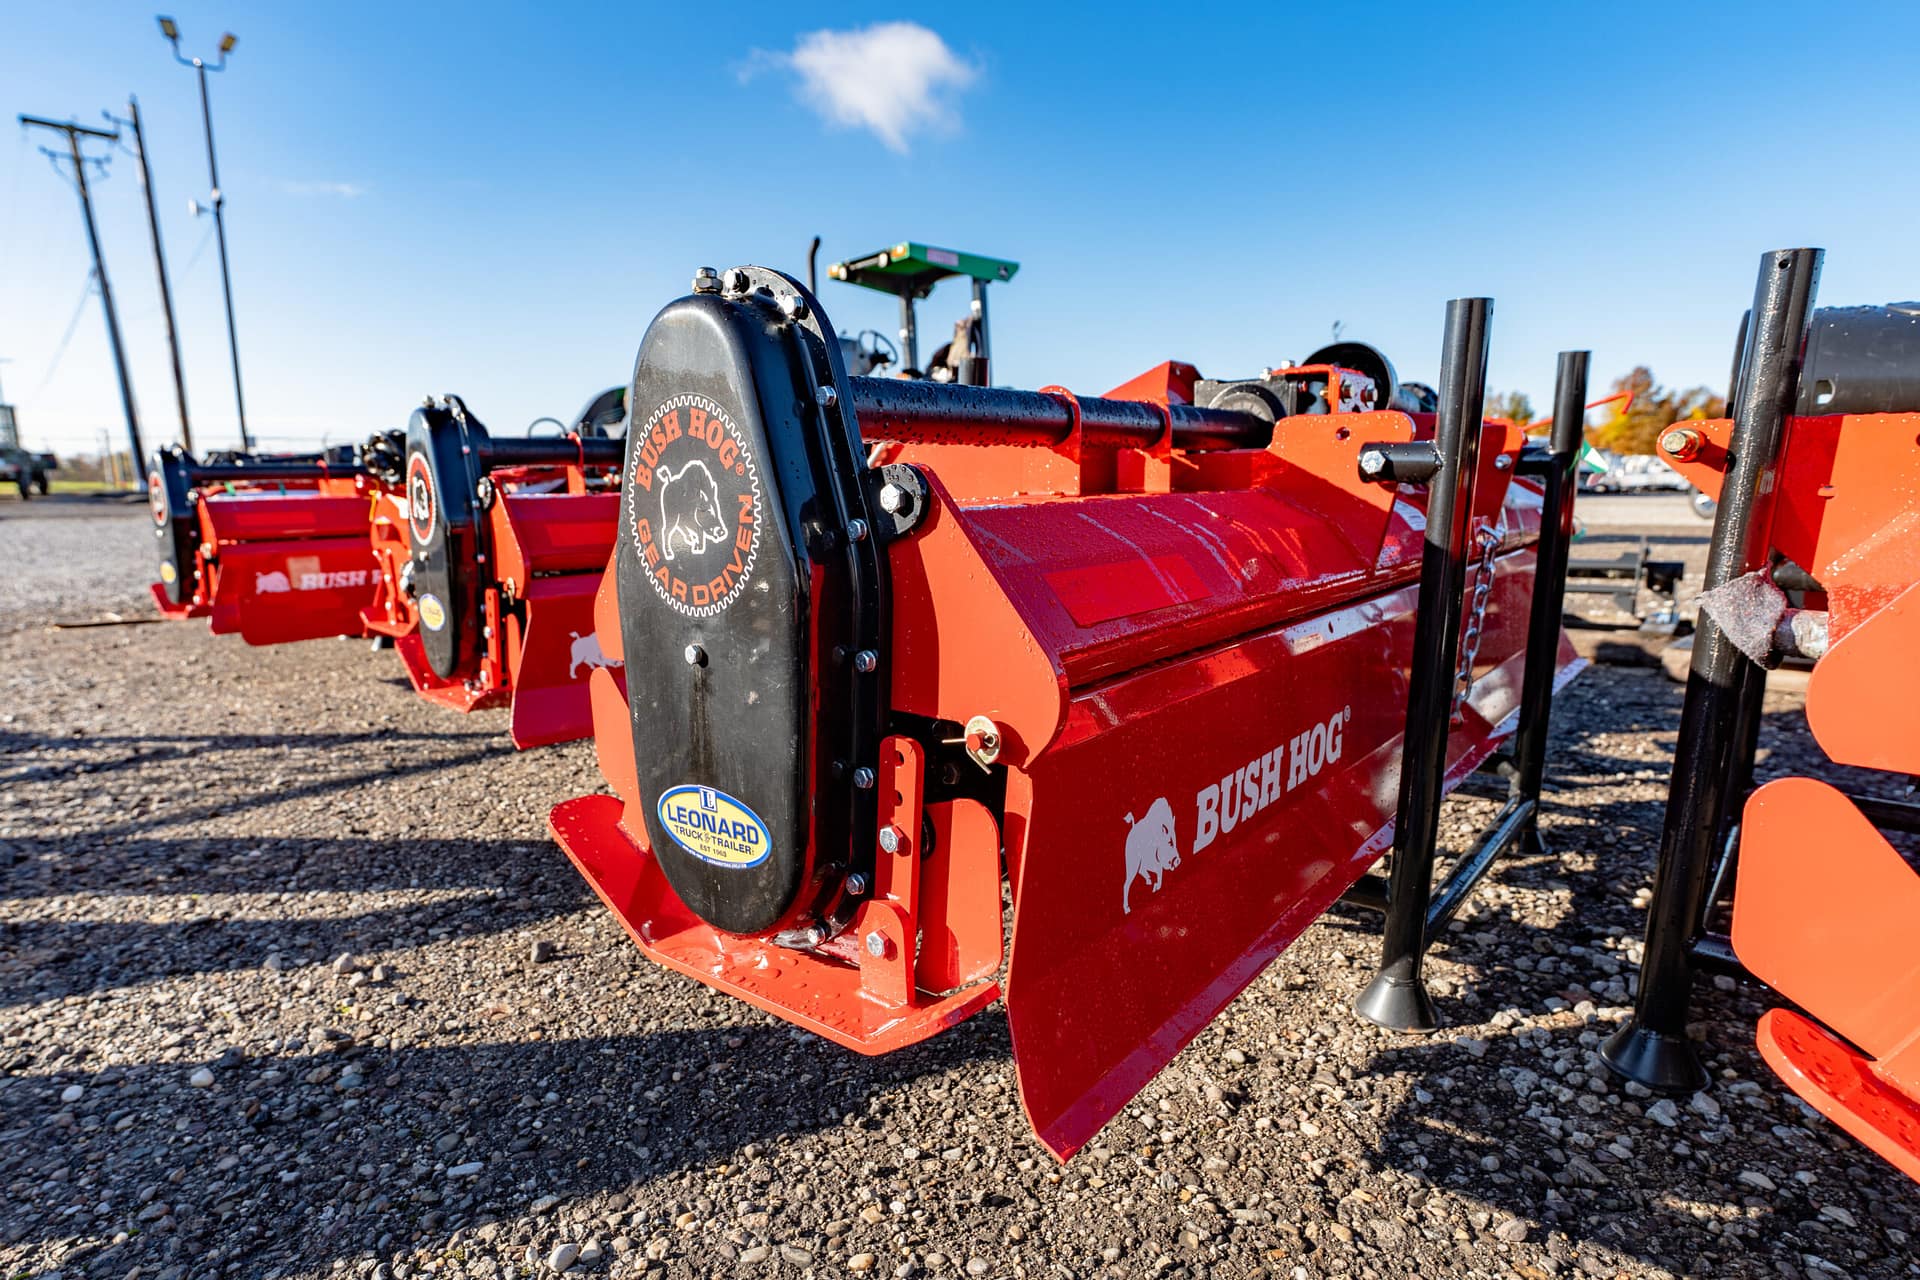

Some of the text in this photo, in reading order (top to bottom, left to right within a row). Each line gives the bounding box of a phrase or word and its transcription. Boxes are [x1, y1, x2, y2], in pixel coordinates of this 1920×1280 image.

[635, 409, 683, 492] BUSH
[637, 494, 753, 606] GEAR DRIVEN
[300, 570, 367, 591] BUSH
[1193, 745, 1284, 855] BUSH
[667, 803, 759, 845] LEONARD
[674, 825, 703, 842] TRUCK
[711, 835, 752, 856] TRAILER
[700, 844, 711, 853] EST
